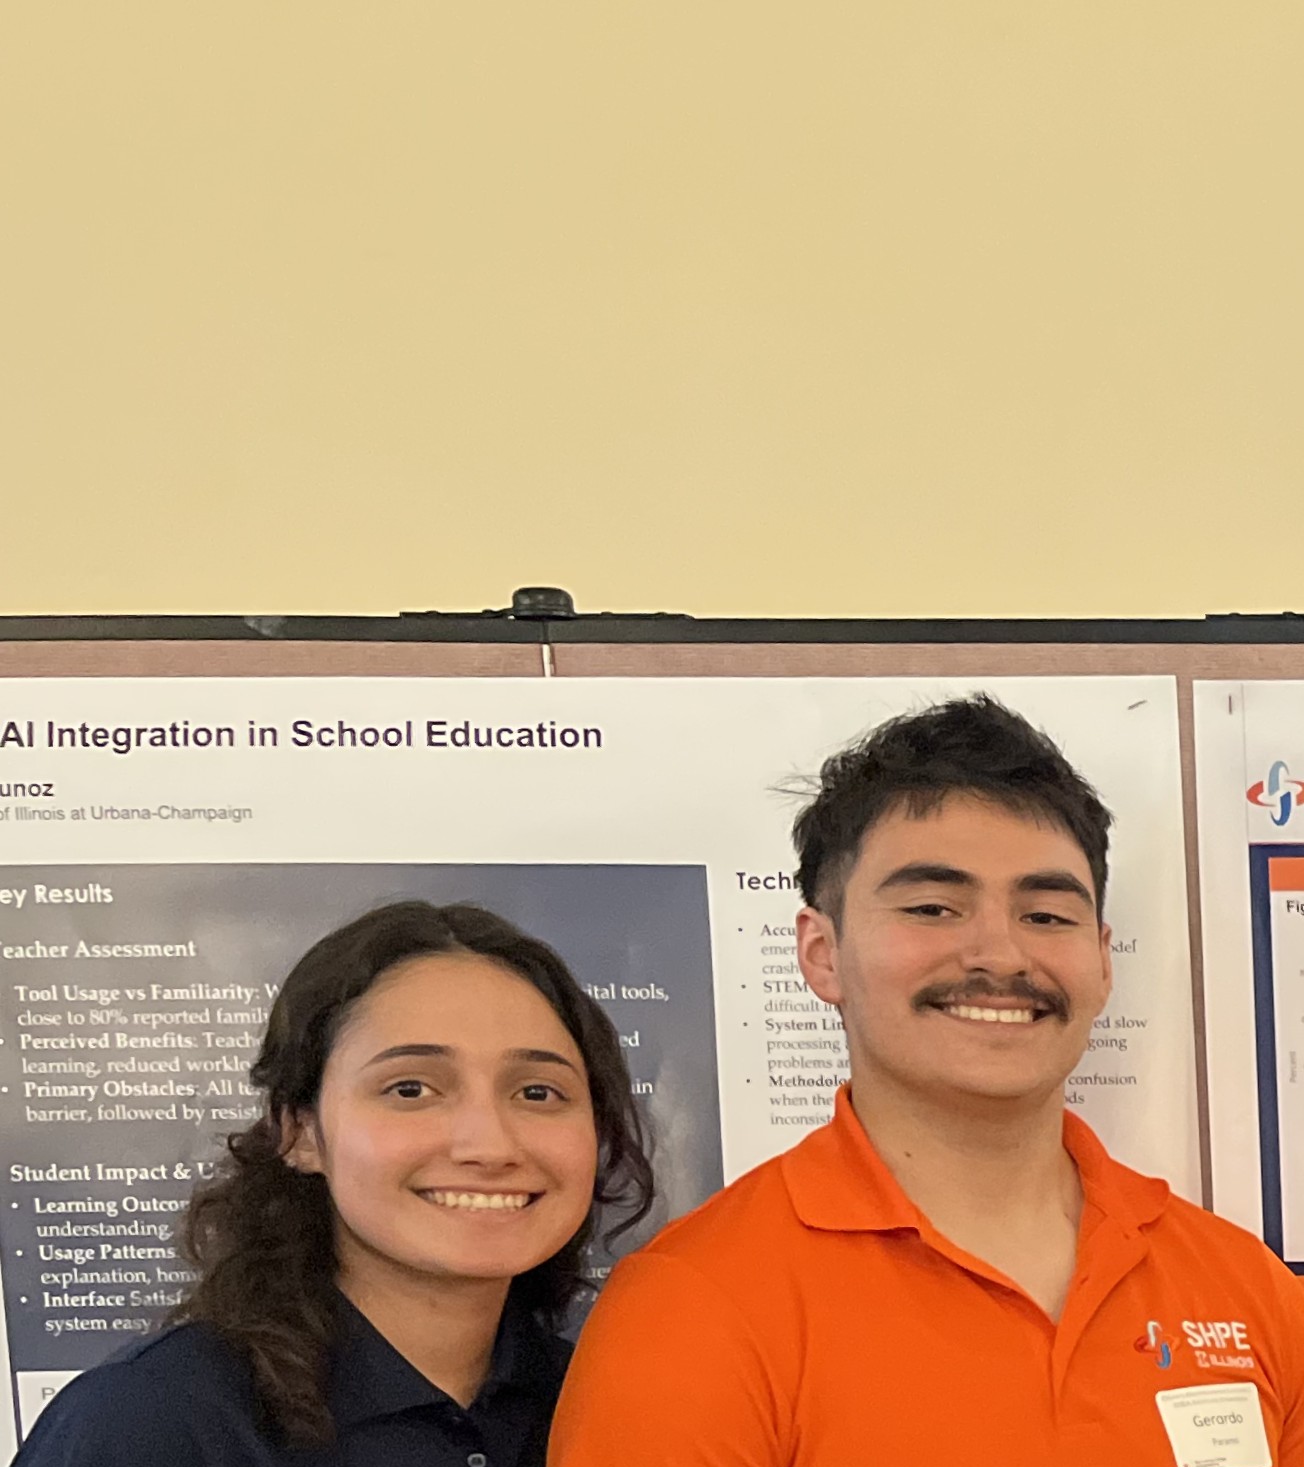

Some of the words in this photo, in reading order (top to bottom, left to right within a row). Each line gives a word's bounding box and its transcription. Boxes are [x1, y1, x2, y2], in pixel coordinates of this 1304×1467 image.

[0, 720, 34, 748] AI
[47, 720, 235, 755] Integration
[248, 720, 278, 747] in
[291, 720, 412, 748] School
[426, 720, 602, 748] Education
[14, 806, 66, 821] Illinois
[70, 806, 87, 821] at
[89, 804, 253, 824] Urbana-Champaign
[33, 883, 114, 904] Results
[73, 939, 197, 958] Assessment
[13, 984, 59, 1002] Tool
[62, 984, 121, 1006] Usage
[124, 988, 147, 1001] vs
[150, 983, 260, 1005] Familiarity:
[17, 1008, 63, 1027] close
[66, 1010, 86, 1026] to
[89, 1008, 129, 1026] 80%
[132, 1007, 211, 1030] reported
[764, 1017, 815, 1035] System
[1114, 1015, 1149, 1030] slow
[19, 1032, 110, 1050] Perceived
[766, 1039, 842, 1055] processing
[1085, 1035, 1128, 1054] going
[21, 1056, 102, 1079] learning,
[106, 1055, 181, 1074] reduced
[1067, 1071, 1138, 1087] confusion
[23, 1080, 99, 1102] Primary
[25, 1102, 94, 1124] barrier,
[97, 1102, 178, 1121] followed
[181, 1103, 206, 1126] by
[9, 1163, 92, 1183] Student
[95, 1163, 168, 1186] Impact
[172, 1162, 192, 1180] &
[33, 1196, 119, 1218] Learning
[1182, 1320, 1251, 1350] SHPE
[1192, 1411, 1245, 1428] Gerardo
